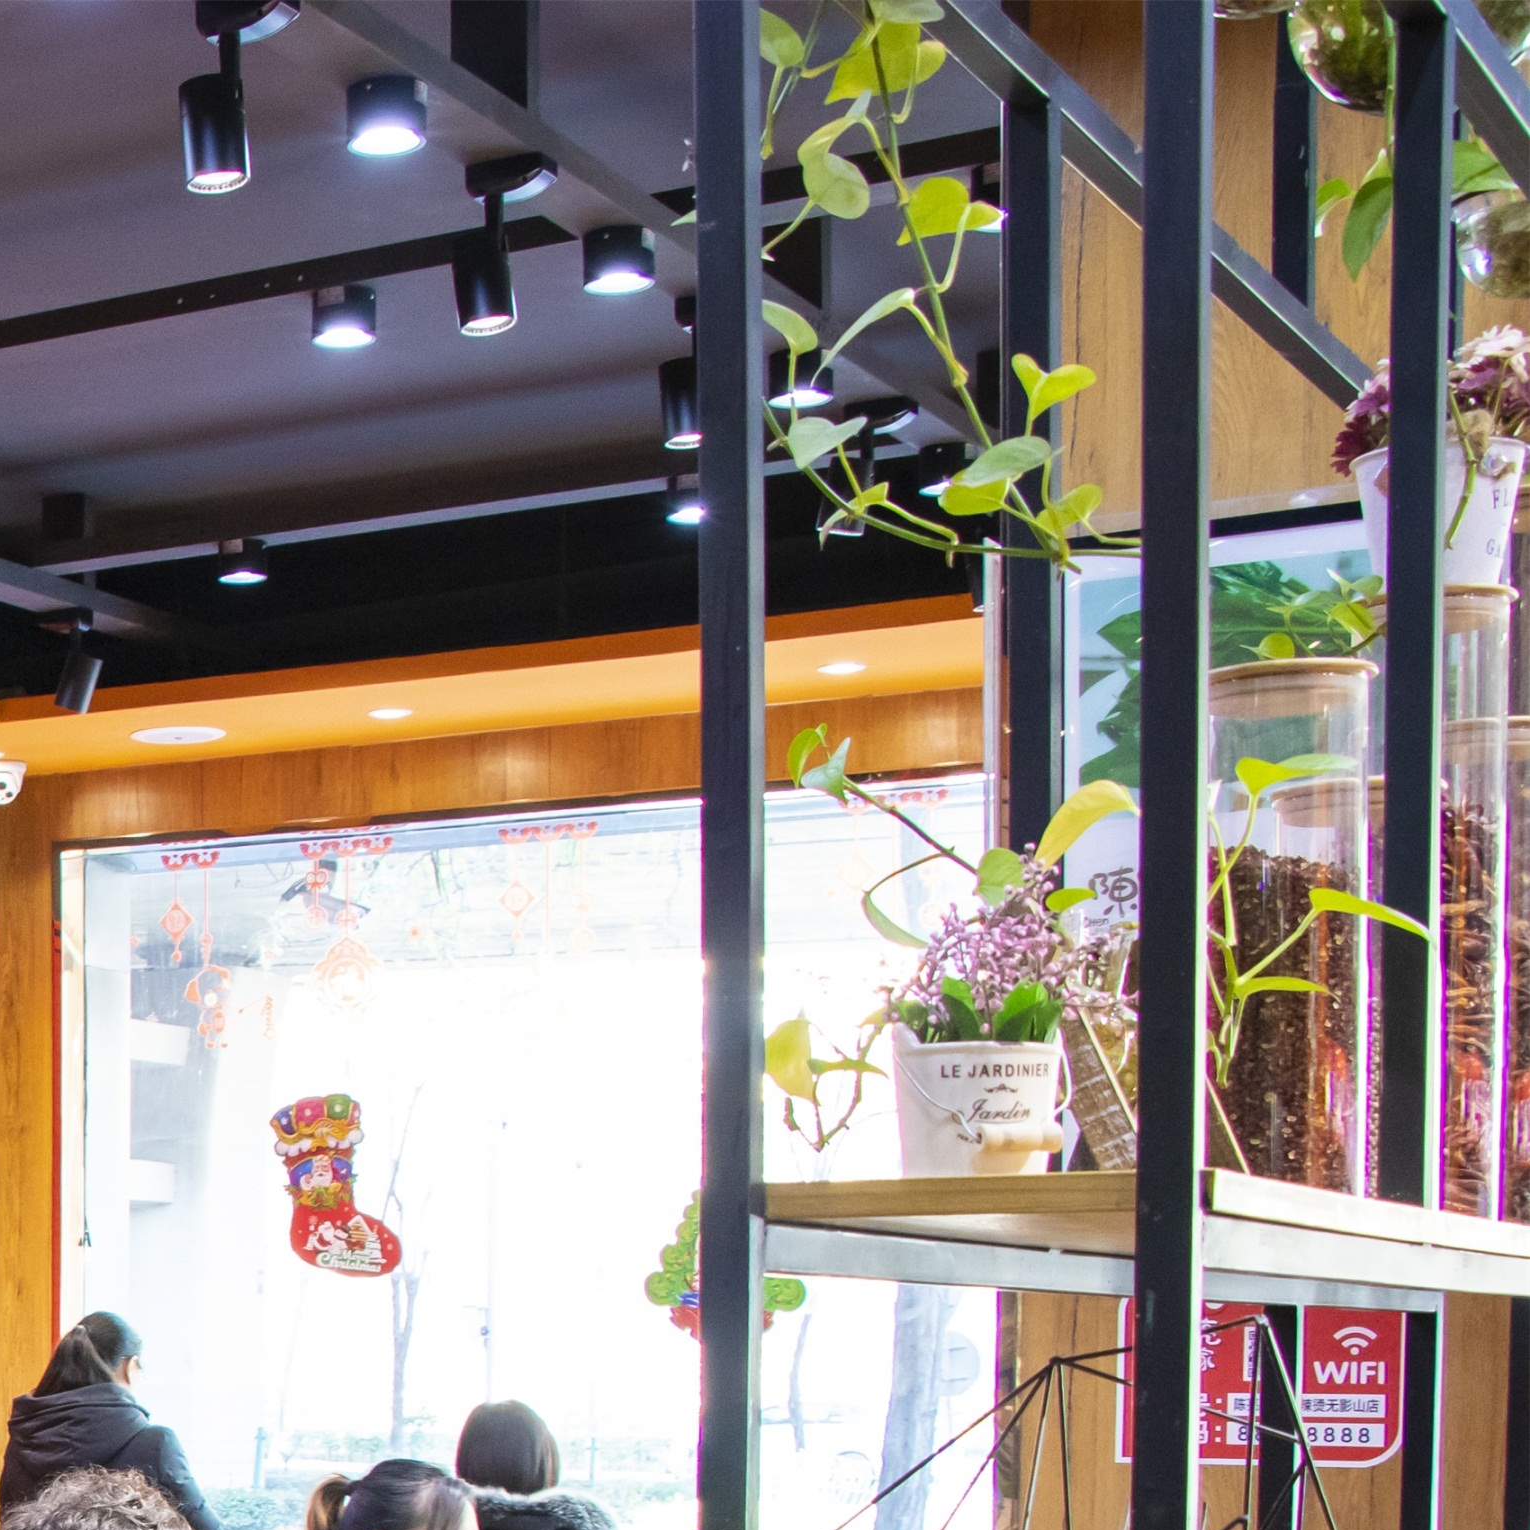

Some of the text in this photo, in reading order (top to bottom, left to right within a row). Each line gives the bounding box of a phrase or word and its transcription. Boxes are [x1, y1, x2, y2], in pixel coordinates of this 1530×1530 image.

[940, 1063, 1049, 1078] LE JARDINIER
[966, 1098, 1031, 1123] Jardin
